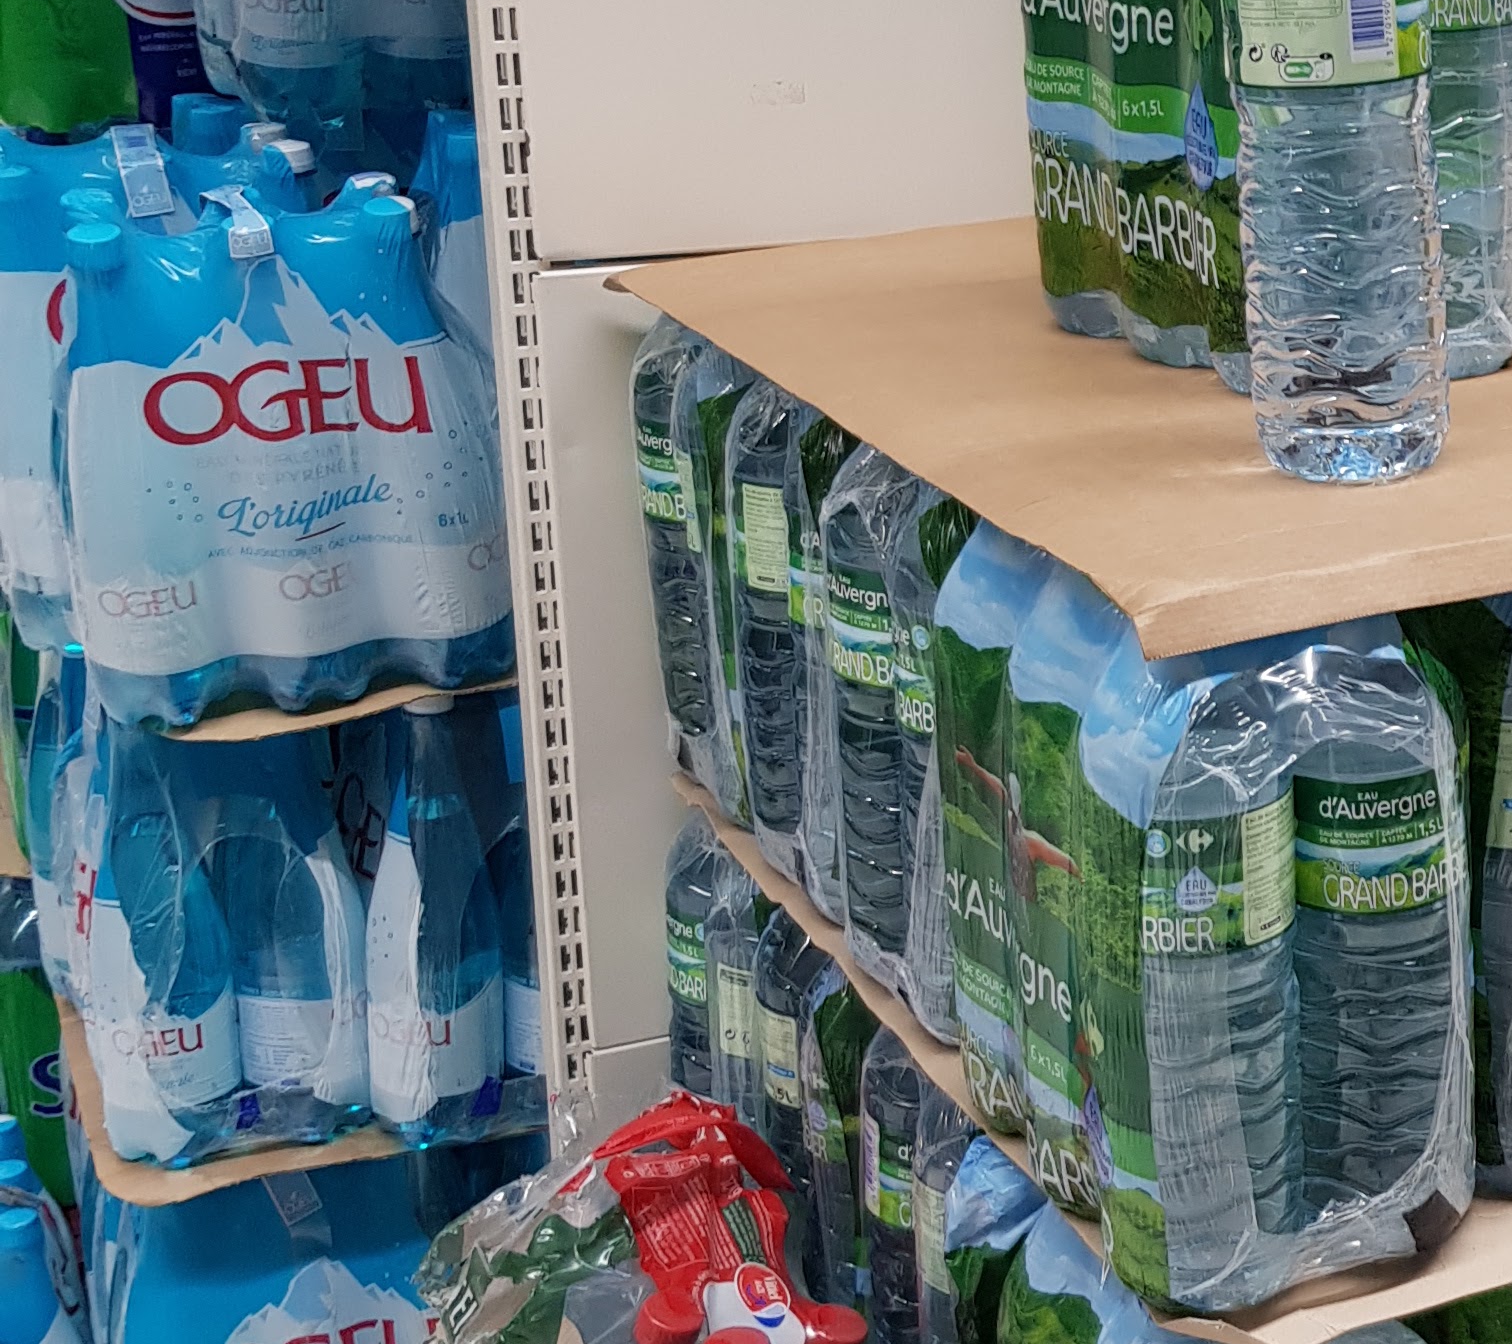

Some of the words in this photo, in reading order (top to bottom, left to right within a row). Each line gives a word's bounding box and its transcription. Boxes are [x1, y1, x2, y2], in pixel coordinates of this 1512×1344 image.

[1033, 79, 1082, 97] MONTAGNE
[1049, 65, 1085, 81] SOURCE
[1033, 155, 1116, 238] GRAND
[1116, 186, 1220, 290] BARBIER
[143, 356, 434, 446] OGEU
[217, 473, 393, 537] L'originale
[1318, 788, 1436, 821] d'Auvergne
[1357, 790, 1378, 802] EAU
[1186, 878, 1207, 893] EAU
[1322, 872, 1409, 910] GRAND
[1141, 916, 1215, 954] RBIER
